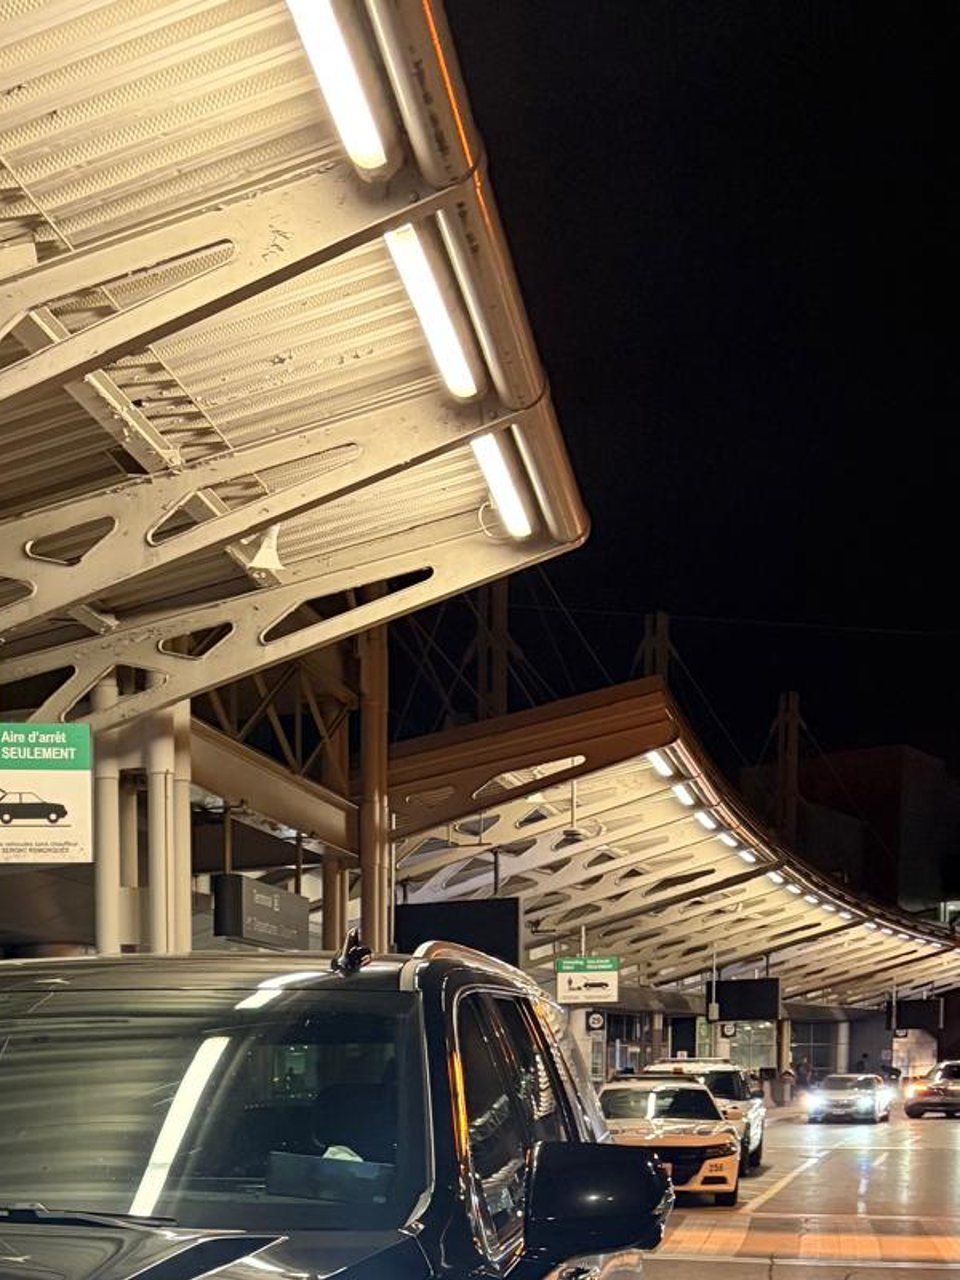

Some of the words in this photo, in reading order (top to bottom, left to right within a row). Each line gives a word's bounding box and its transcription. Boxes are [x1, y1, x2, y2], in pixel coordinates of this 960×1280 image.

[1, 731, 25, 743] Aire
[28, 731, 66, 743] d'arrêt
[1, 747, 77, 760] SEULEMENT
